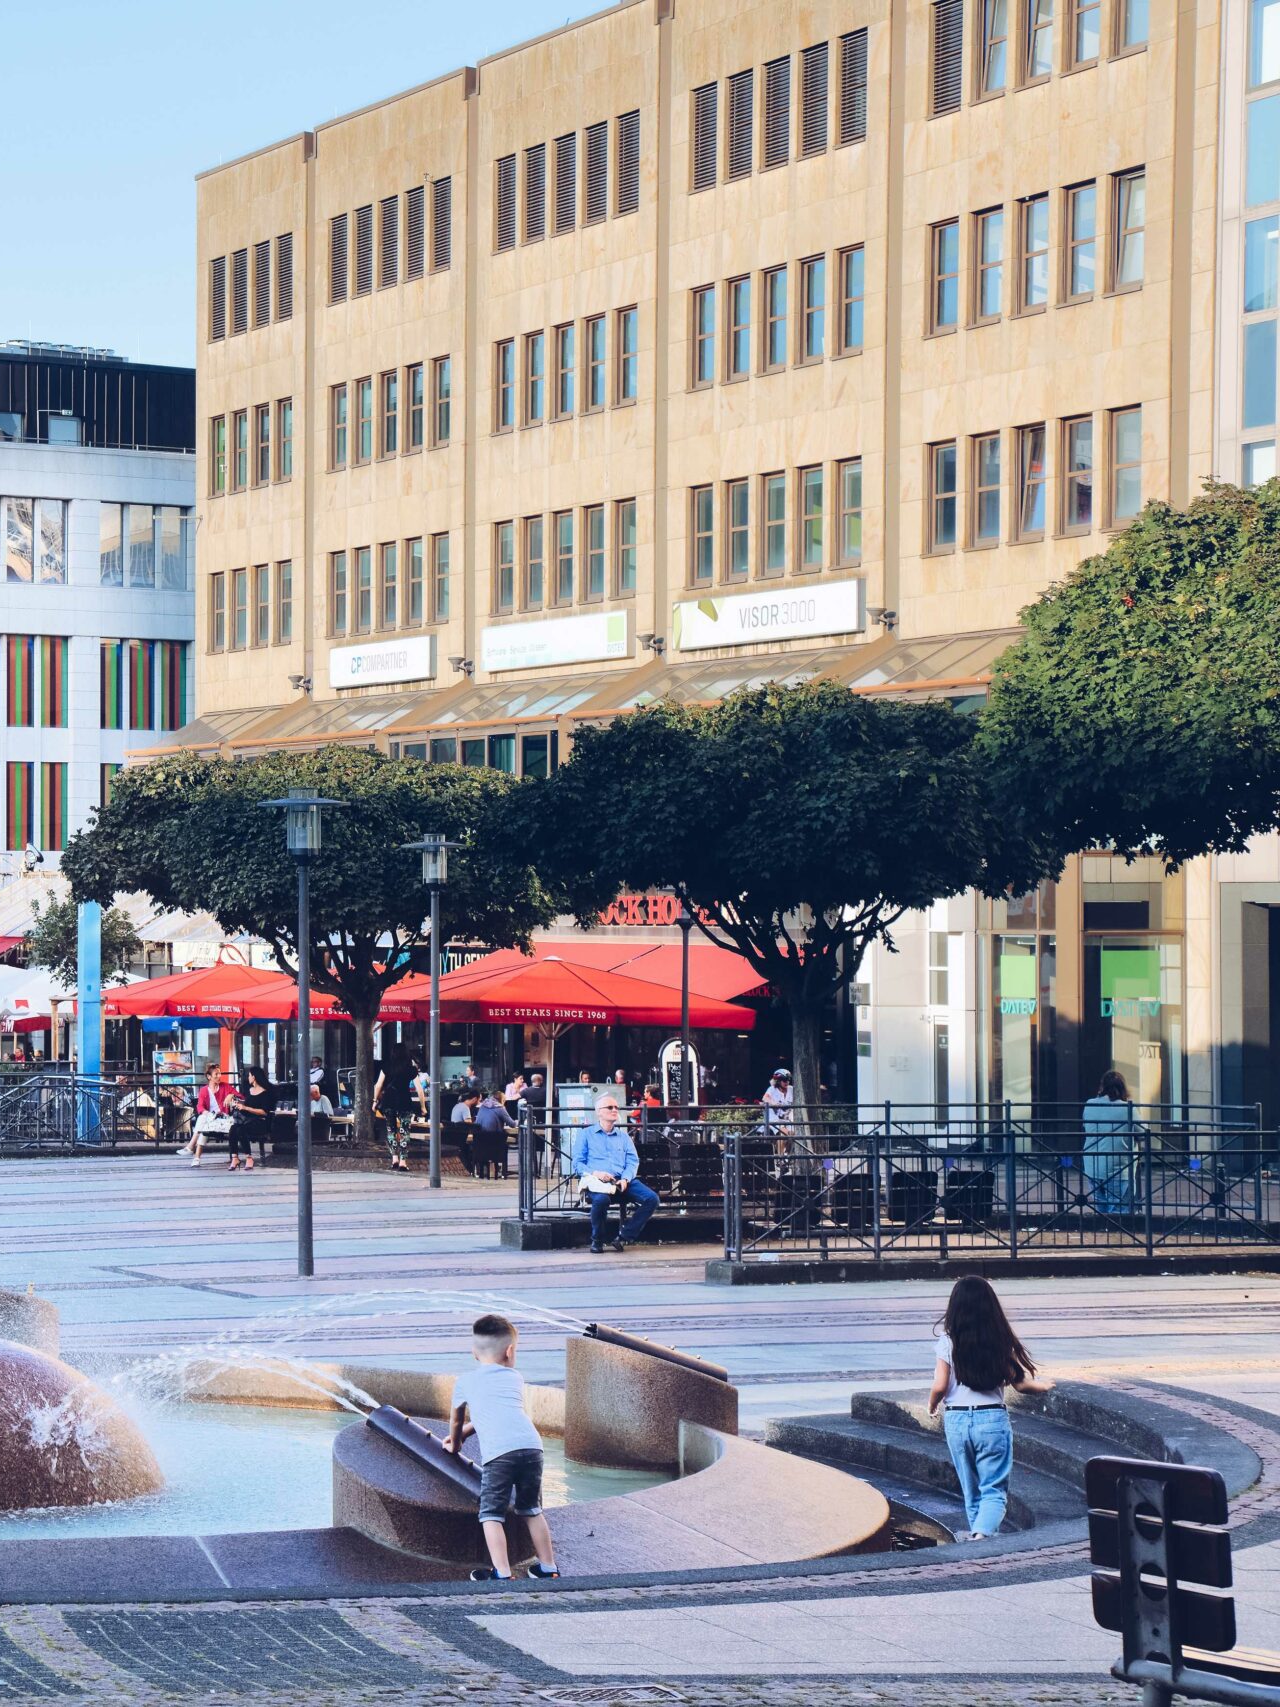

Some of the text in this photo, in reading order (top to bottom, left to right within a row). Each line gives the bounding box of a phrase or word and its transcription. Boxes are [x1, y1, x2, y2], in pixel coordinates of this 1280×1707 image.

[739, 600, 816, 629] VISOR 3000
[489, 1008, 607, 1019] BEST STEAKS SINCE 1968
[1001, 999, 1036, 1014] DATEV
[1101, 1000, 1160, 1017] DATEV
